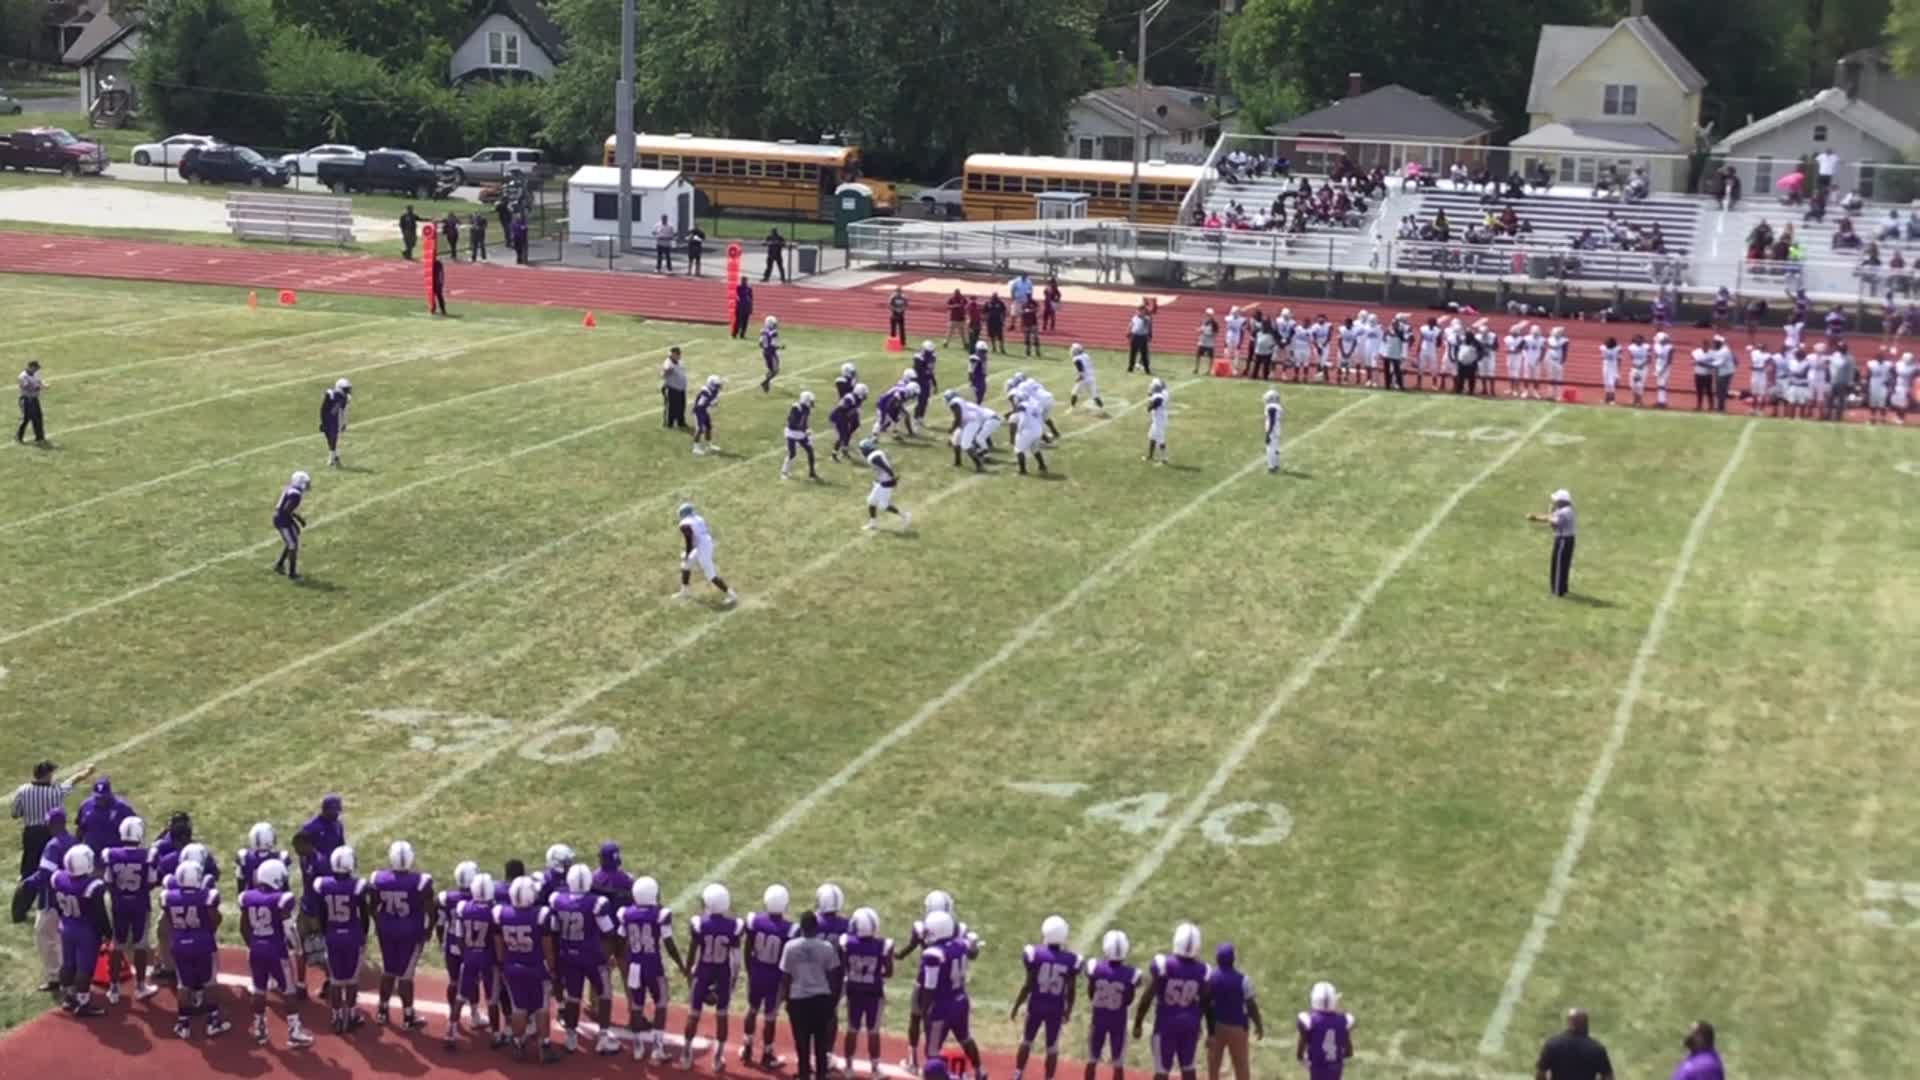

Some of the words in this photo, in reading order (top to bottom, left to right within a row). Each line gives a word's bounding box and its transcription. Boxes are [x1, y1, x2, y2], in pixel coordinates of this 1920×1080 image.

[1085, 791, 1295, 845] 40
[169, 905, 200, 929] 54
[324, 894, 351, 923] 15
[380, 891, 411, 917] 75
[463, 919, 489, 948] 17
[502, 925, 533, 953] 55
[754, 931, 782, 964] 40
[702, 934, 730, 964] 16
[1037, 962, 1068, 996] 45
[1321, 1027, 1337, 1061] 4
